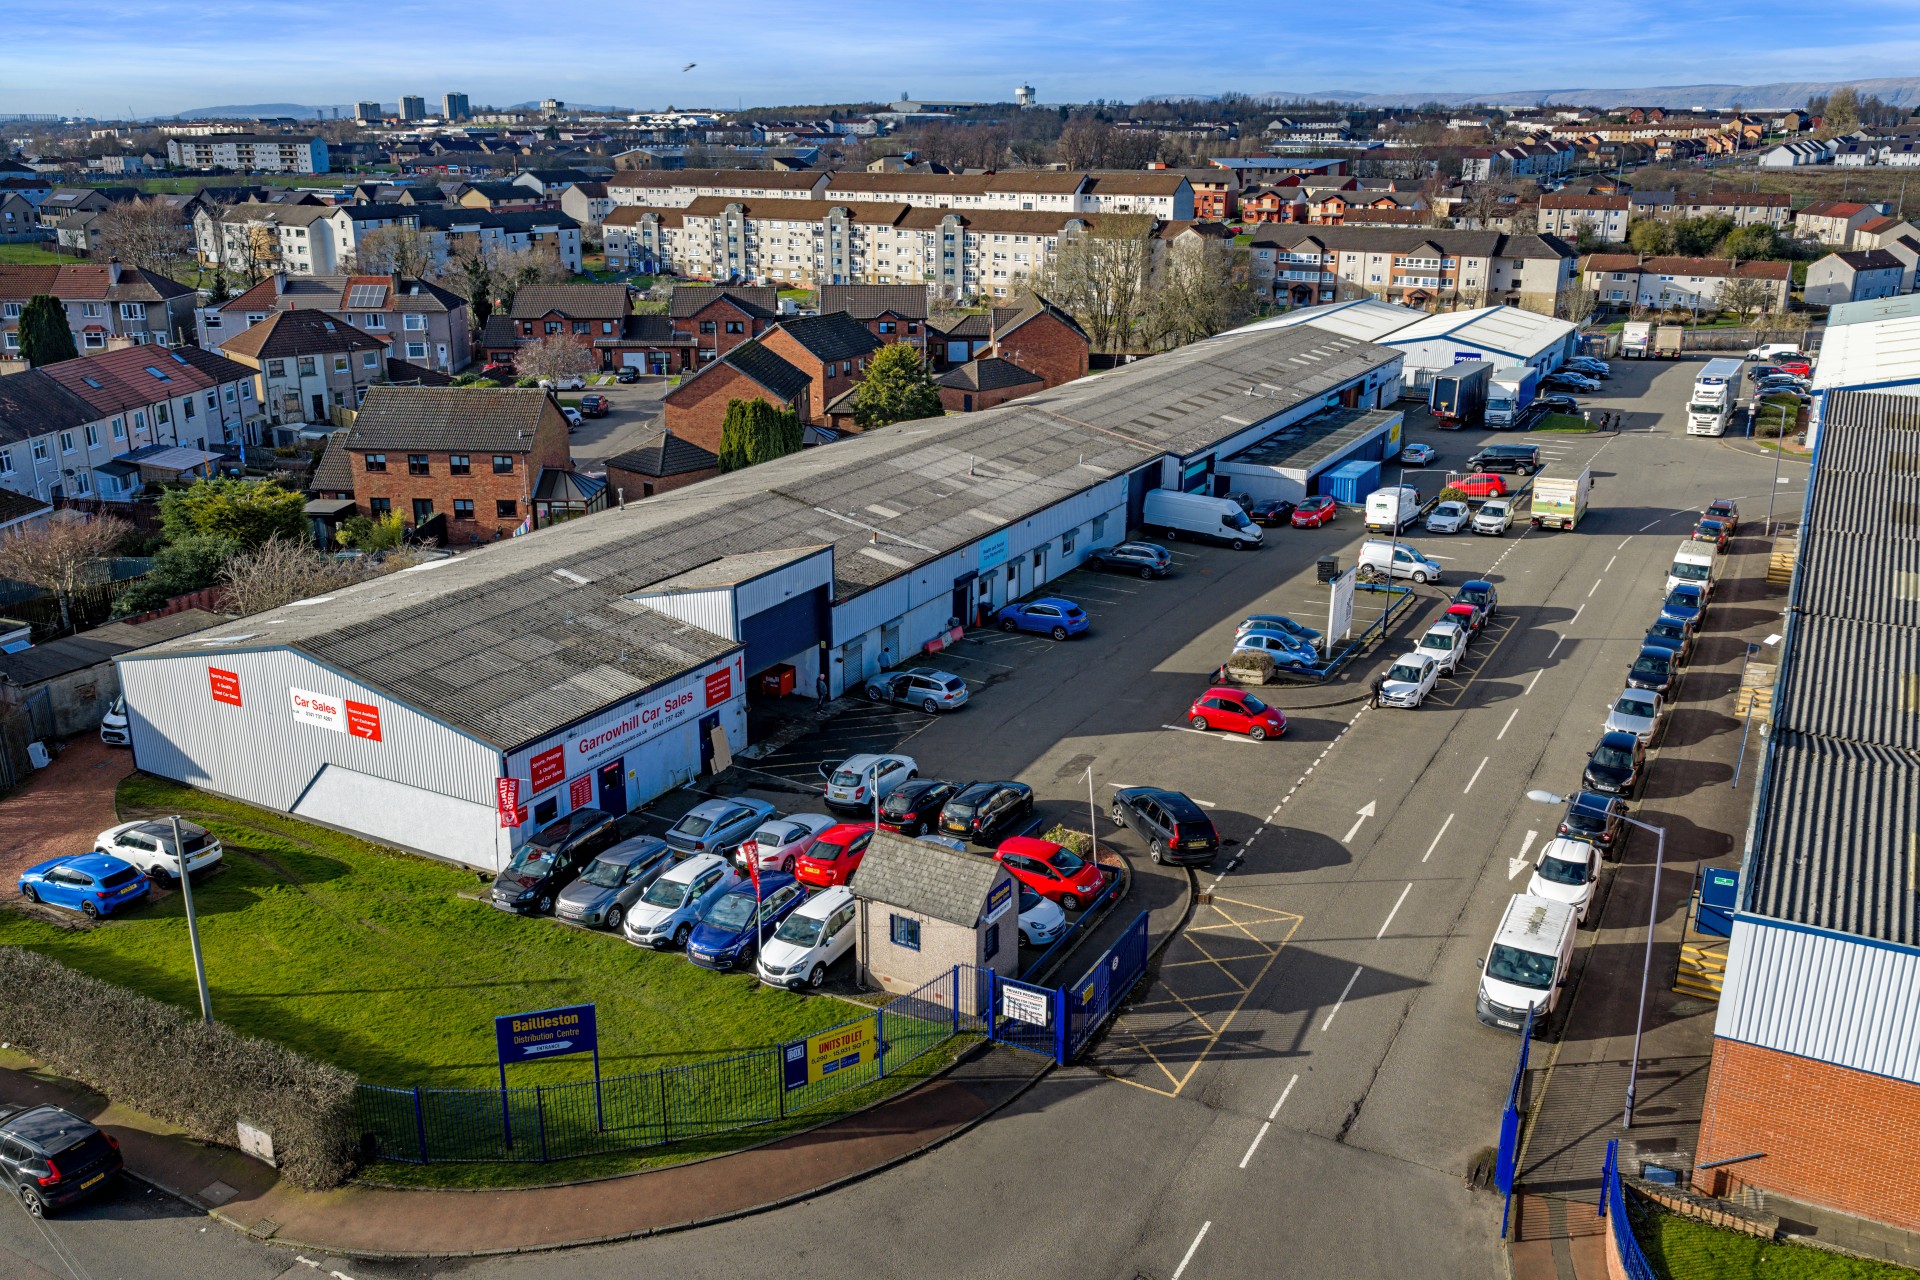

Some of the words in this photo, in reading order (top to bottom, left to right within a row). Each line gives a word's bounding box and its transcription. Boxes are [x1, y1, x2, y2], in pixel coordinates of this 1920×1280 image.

[1122, 476, 1127, 495] 2
[735, 656, 742, 682] 1
[294, 695, 309, 708] Car
[312, 700, 336, 714] Sales
[579, 715, 638, 754] Garrowhill
[642, 706, 661, 724] Car
[665, 692, 693, 712] Sales
[653, 719, 664, 729] 0141
[665, 714, 673, 723] 737
[546, 752, 562, 761] Prestige
[543, 763, 556, 773] Quality
[552, 769, 562, 778] Sales
[512, 1014, 578, 1032] Baillieston
[514, 1032, 553, 1044] Distribution
[557, 1028, 579, 1038] Centre
[819, 1038, 840, 1054] UNITS
[841, 1034, 850, 1045] TO
[851, 1030, 862, 1042] LET
[812, 1055, 828, 1064] 5,290
[833, 1047, 850, 1056] 15,931
